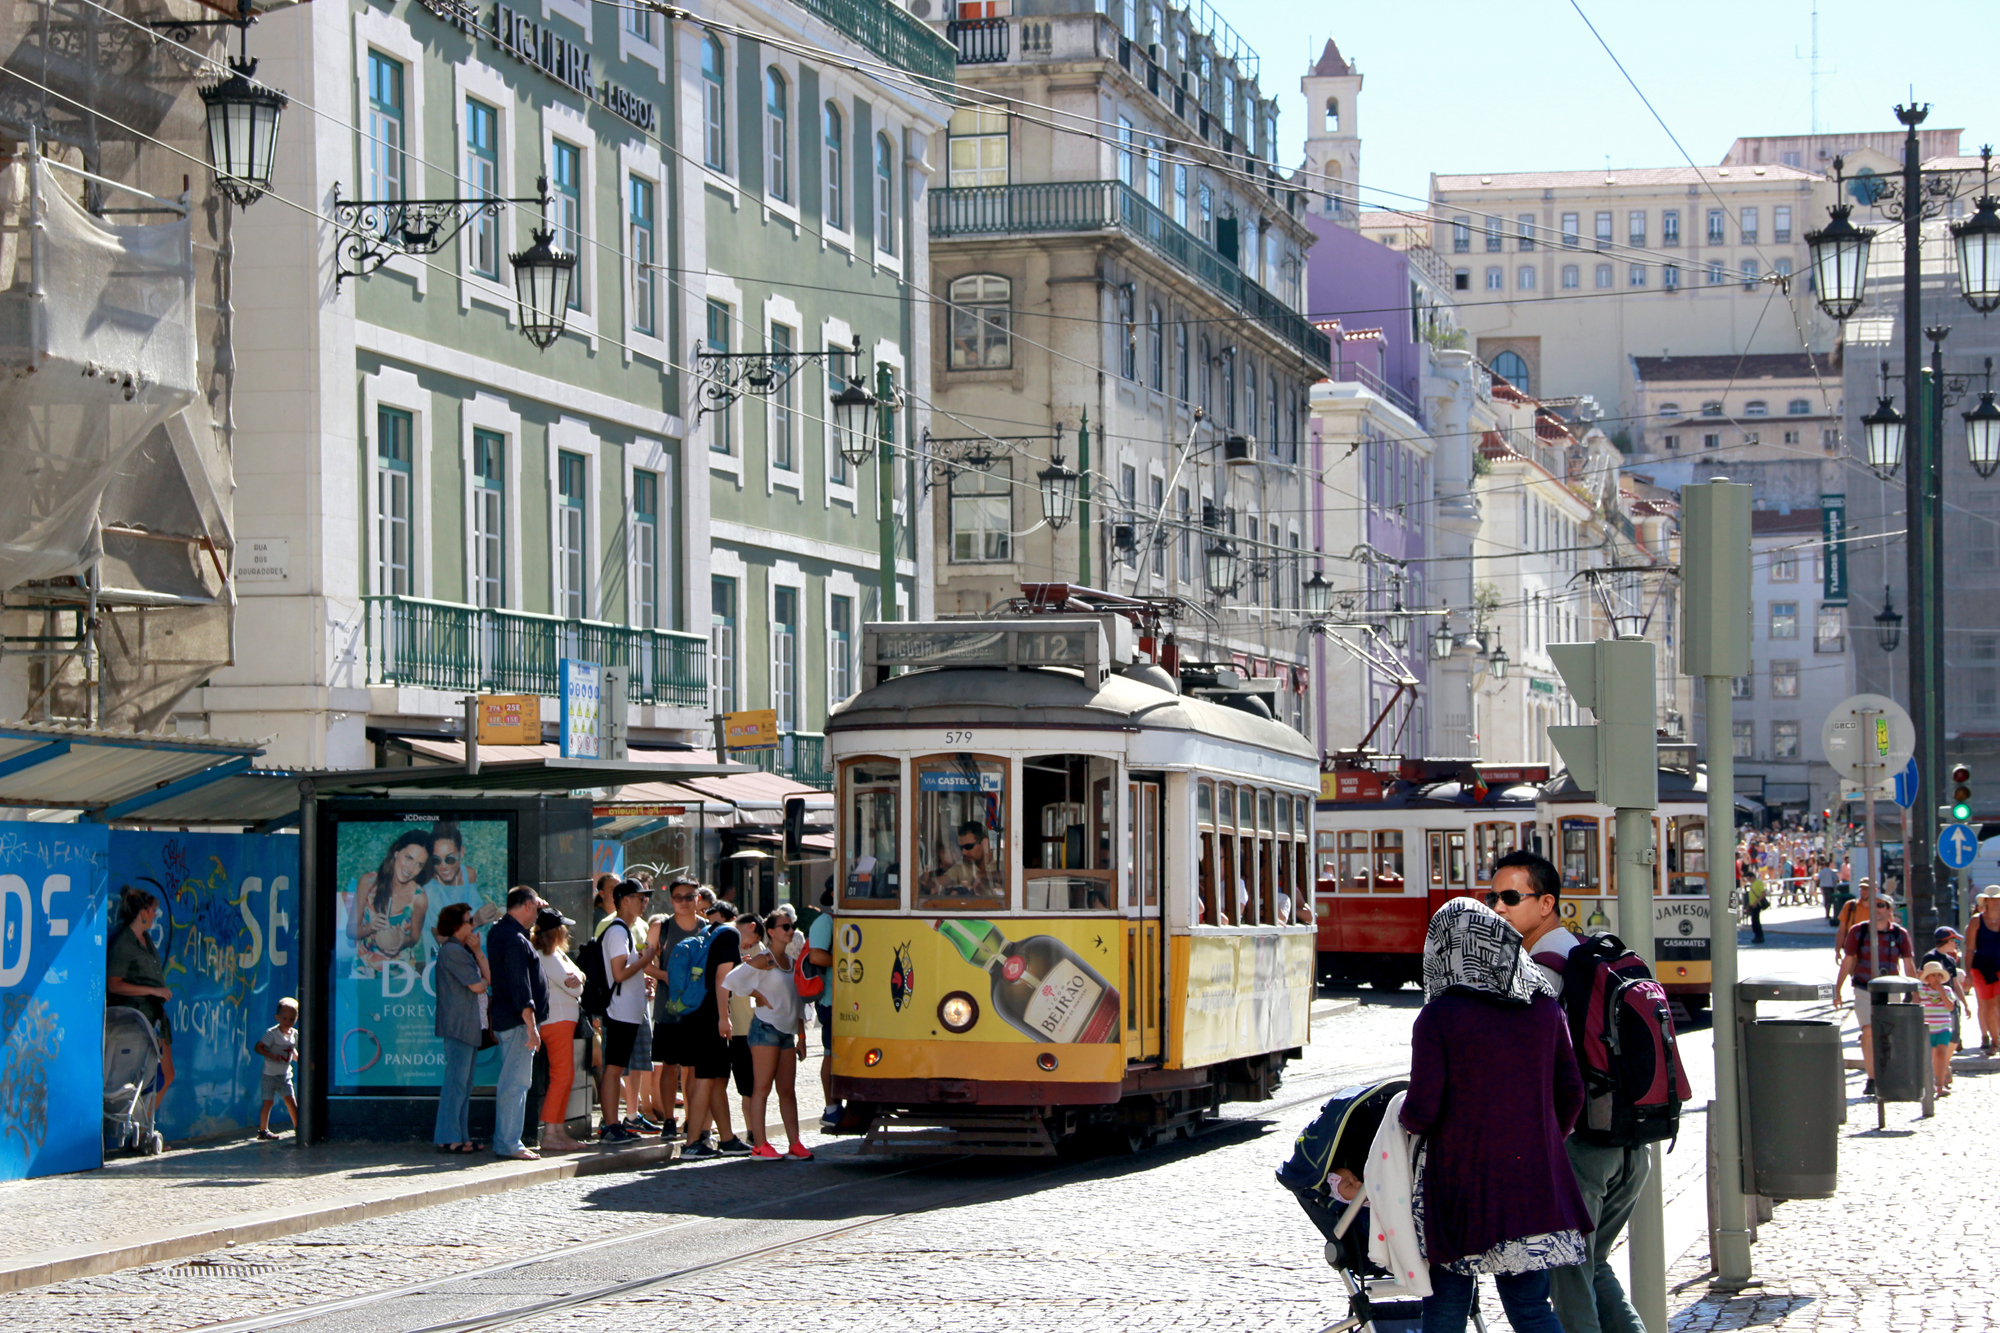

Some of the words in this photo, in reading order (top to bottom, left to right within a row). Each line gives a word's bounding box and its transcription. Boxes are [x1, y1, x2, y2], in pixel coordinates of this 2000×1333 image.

[493, 2, 596, 101] FIGUEIRA
[604, 80, 657, 132] LISBOA
[1829, 510, 1841, 551] Vouga
[238, 567, 284, 575] DOURADORES
[1830, 553, 1839, 593] Tubos
[1035, 634, 1068, 660] 12
[506, 703, 521, 711] 25E
[944, 730, 973, 744] 579
[923, 777, 937, 785] VIA
[937, 776, 978, 786] CASTELO
[1340, 777, 1359, 786] TICKETS
[1341, 786, 1358, 794] INSIDE
[402, 813, 440, 822] JCDecaux
[847, 886, 857, 896] 01
[1655, 903, 1710, 921] JAMESON
[1663, 939, 1706, 947] CASKMATES
[1047, 984, 1066, 1011] LICOR
[1041, 974, 1085, 1034] BEIRÃO
[383, 1004, 437, 1017] FOREV
[839, 1012, 860, 1022] BEIRÃO
[384, 1050, 447, 1066] PANDOR
[403, 1070, 437, 1078] pandora.net
